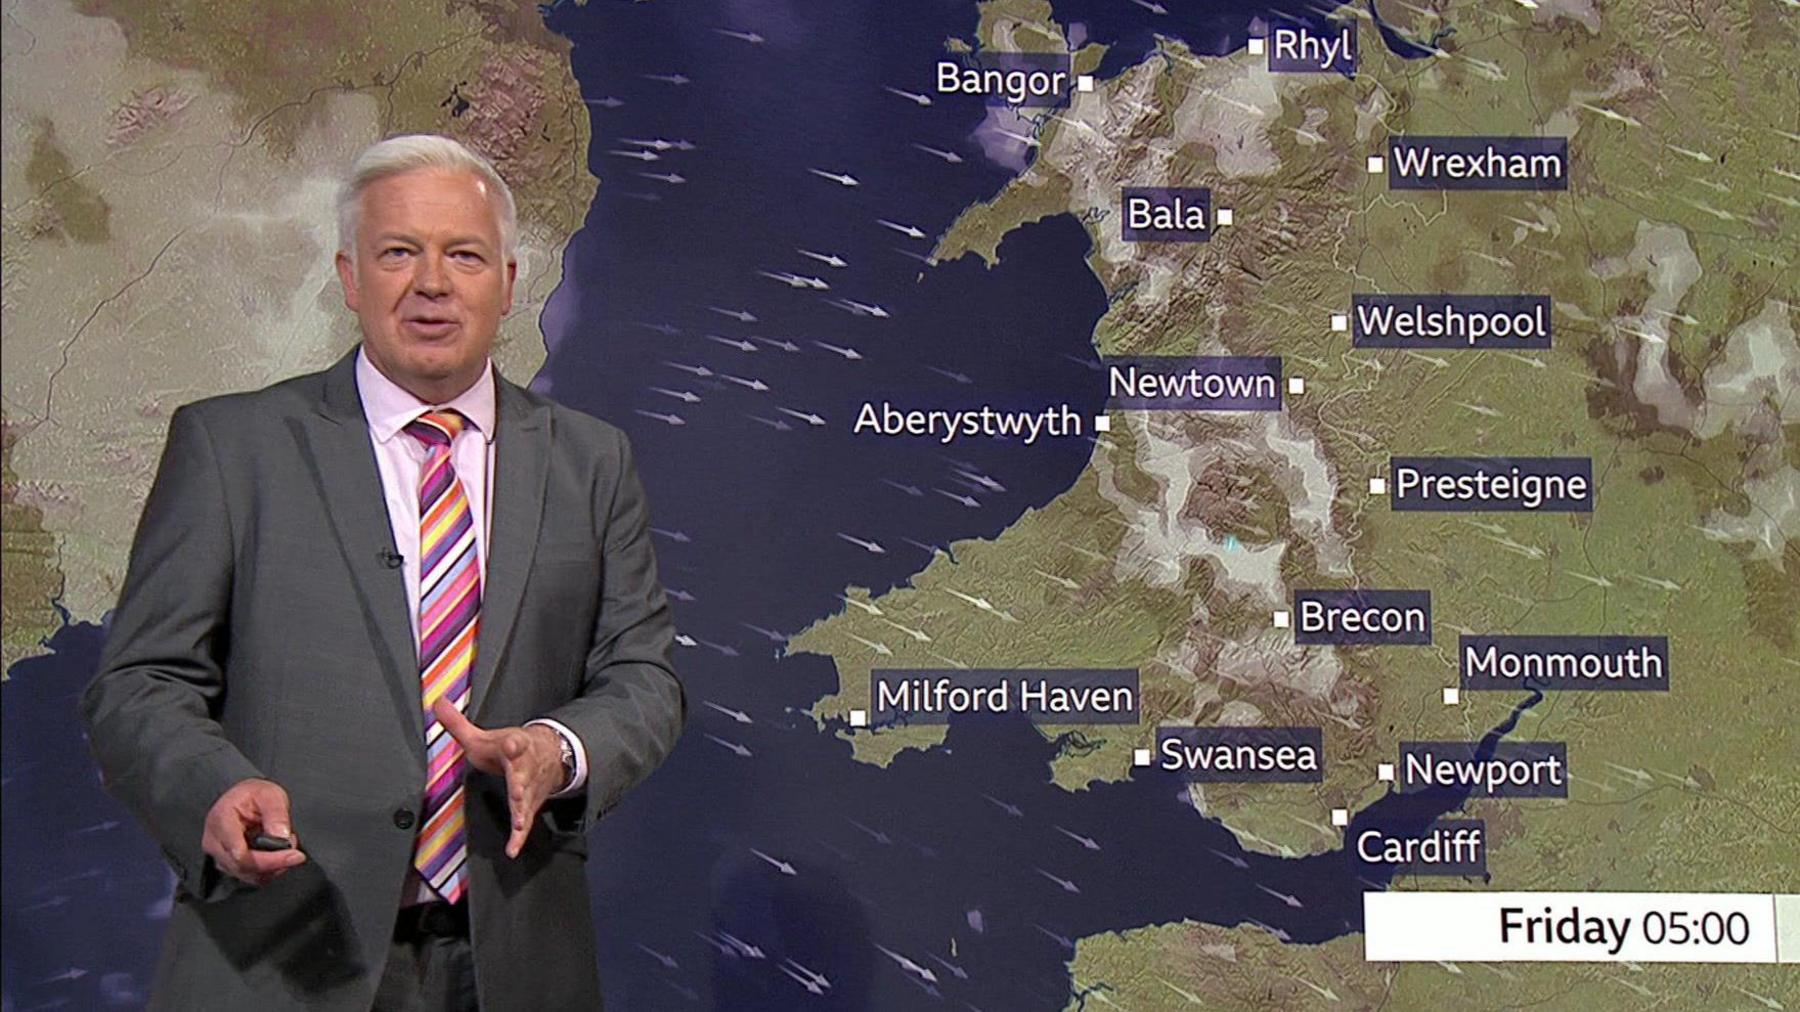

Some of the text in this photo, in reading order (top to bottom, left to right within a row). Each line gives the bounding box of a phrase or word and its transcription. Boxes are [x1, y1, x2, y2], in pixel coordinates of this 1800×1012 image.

[1276, 28, 1352, 69] Rhyl
[938, 62, 1066, 103] Bangor
[1394, 146, 1561, 178] Wrexham
[1129, 197, 1206, 229] Bala
[1357, 305, 1546, 345] Welshpool
[1110, 366, 1275, 398] Newtown
[854, 402, 1081, 444] Aberystwyth
[1398, 468, 1587, 508] Presteigne
[1302, 601, 1424, 632] Brecon
[1466, 646, 1662, 678] Monmouth
[879, 679, 1132, 712] Milford Haven
[1162, 738, 1318, 770] Swansea
[1407, 753, 1562, 793] Newport
[1358, 829, 1481, 863] Cardiff
[1500, 906, 1750, 955] Friday 05:00
